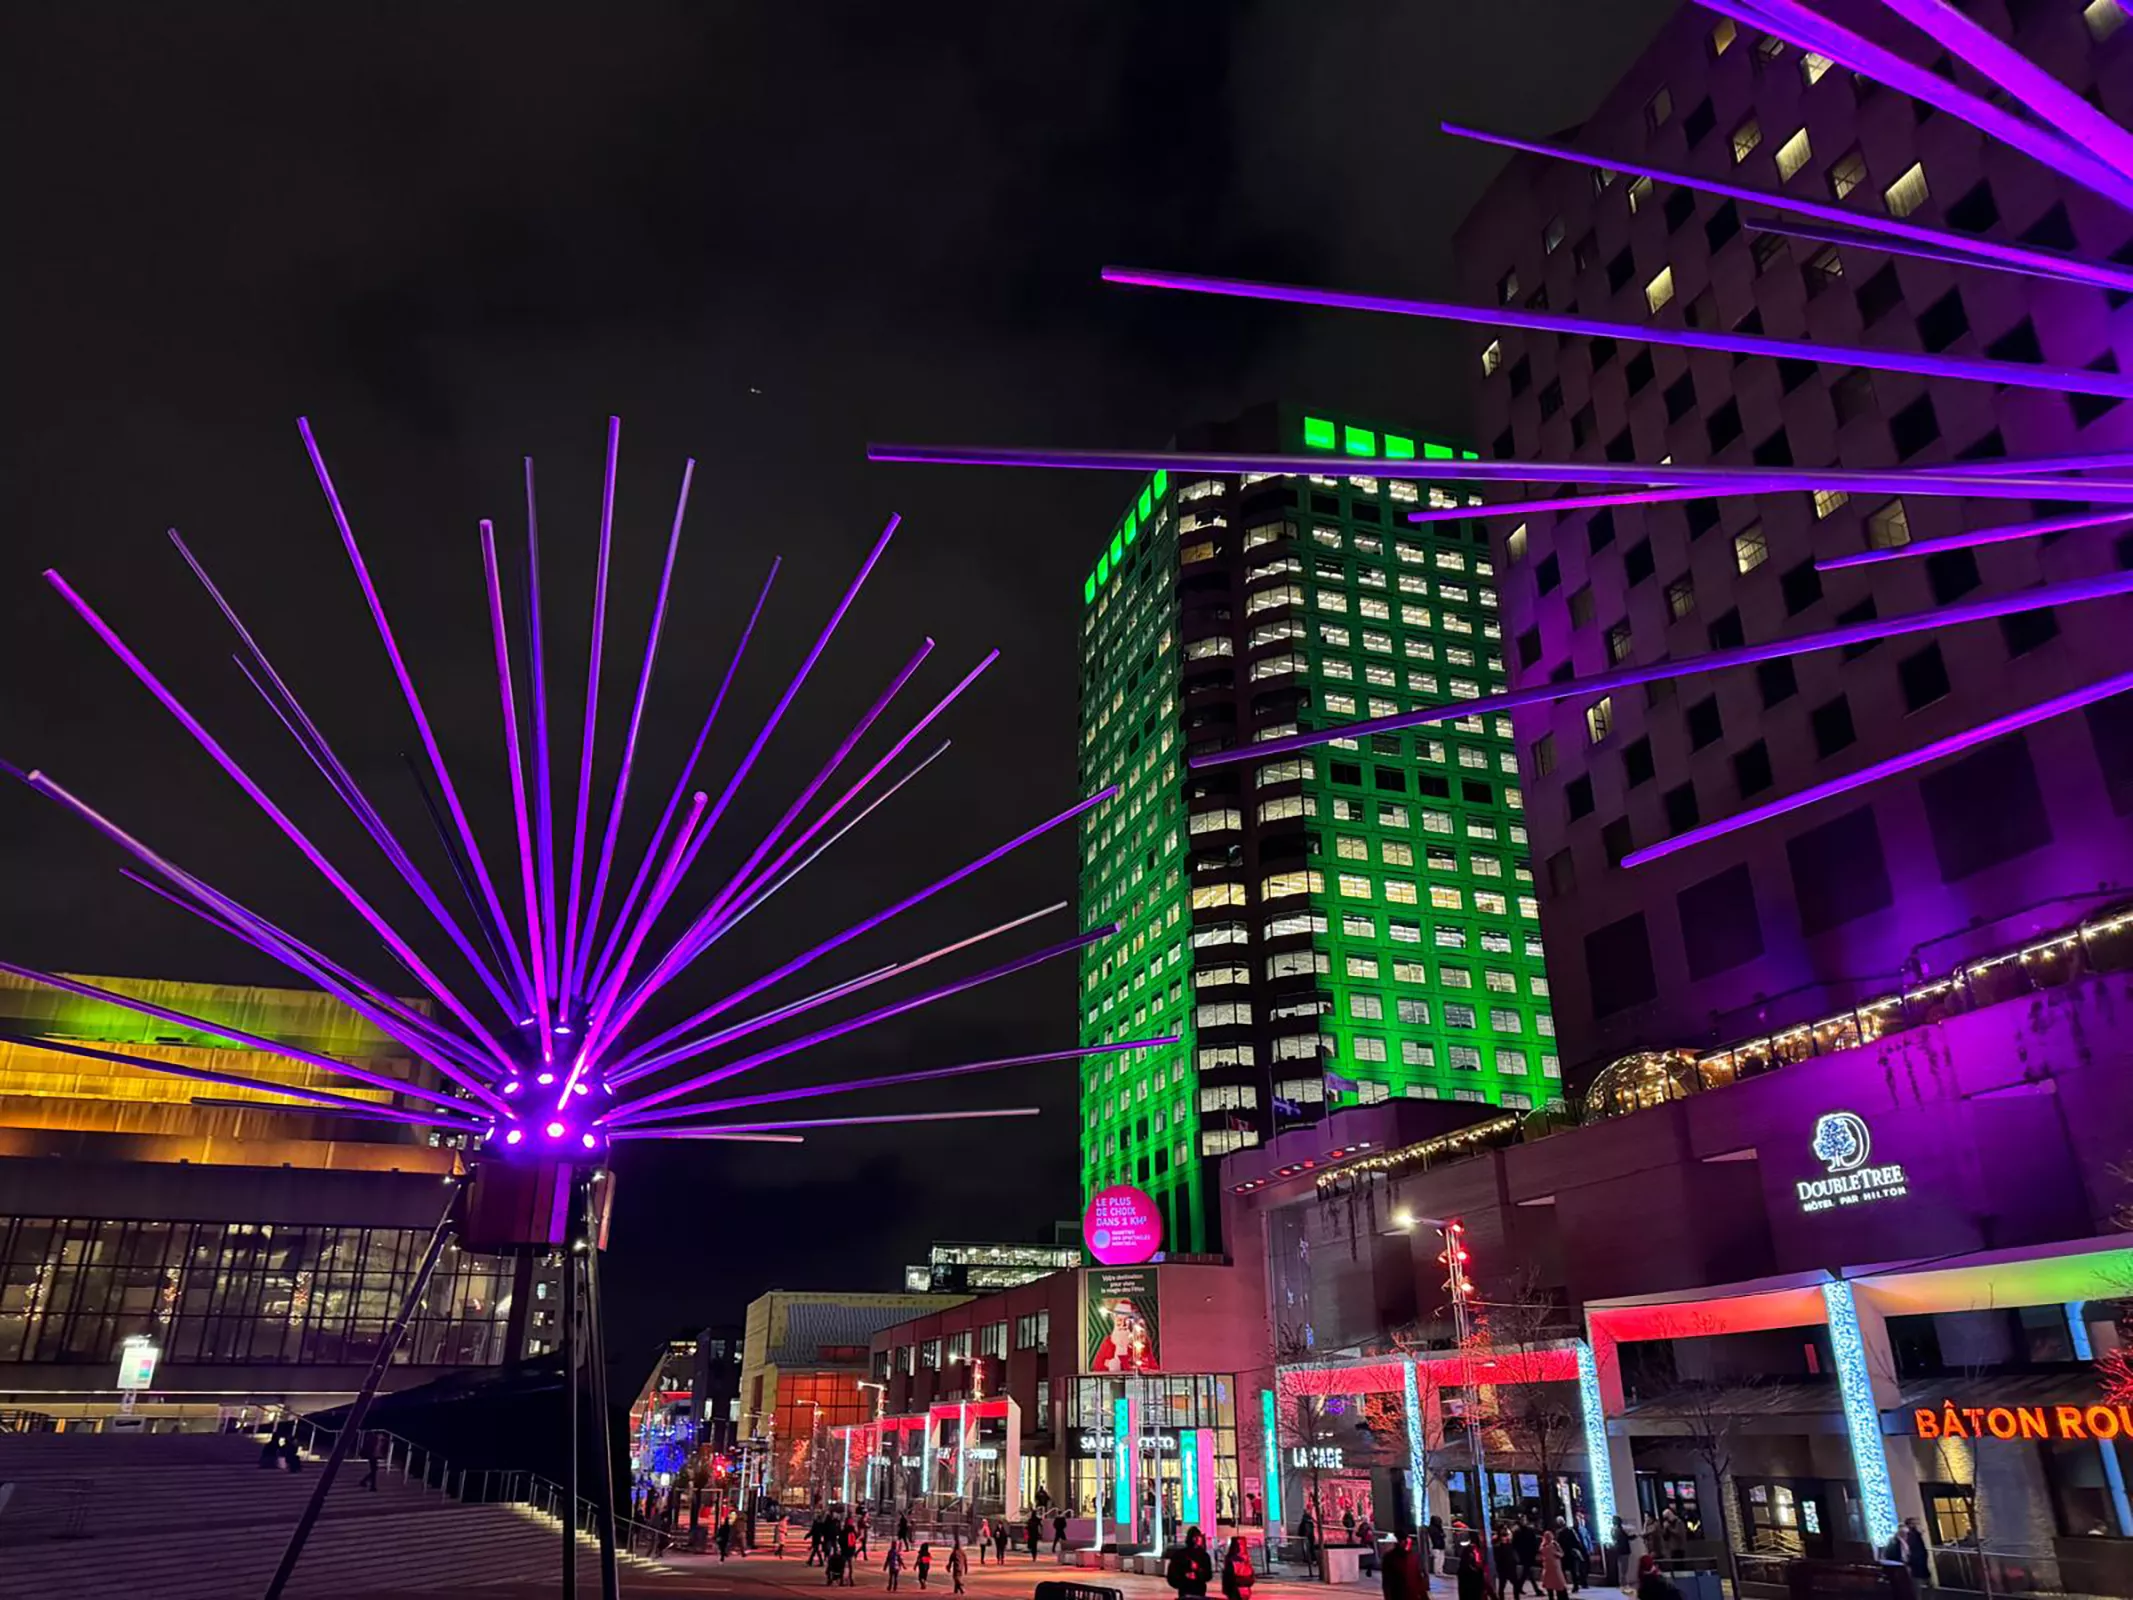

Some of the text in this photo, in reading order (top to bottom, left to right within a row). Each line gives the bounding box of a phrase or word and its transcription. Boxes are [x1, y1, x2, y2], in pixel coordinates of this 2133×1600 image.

[1096, 1196, 1131, 1206] LE PLUS
[1804, 1186, 1906, 1212] HÔTEL PAR HILTON
[1096, 1206, 1136, 1217] DE CHOIX
[1096, 1217, 1120, 1226] DANS
[1915, 1400, 2049, 1439] BÂTON
[1293, 1447, 1308, 1468] LA
